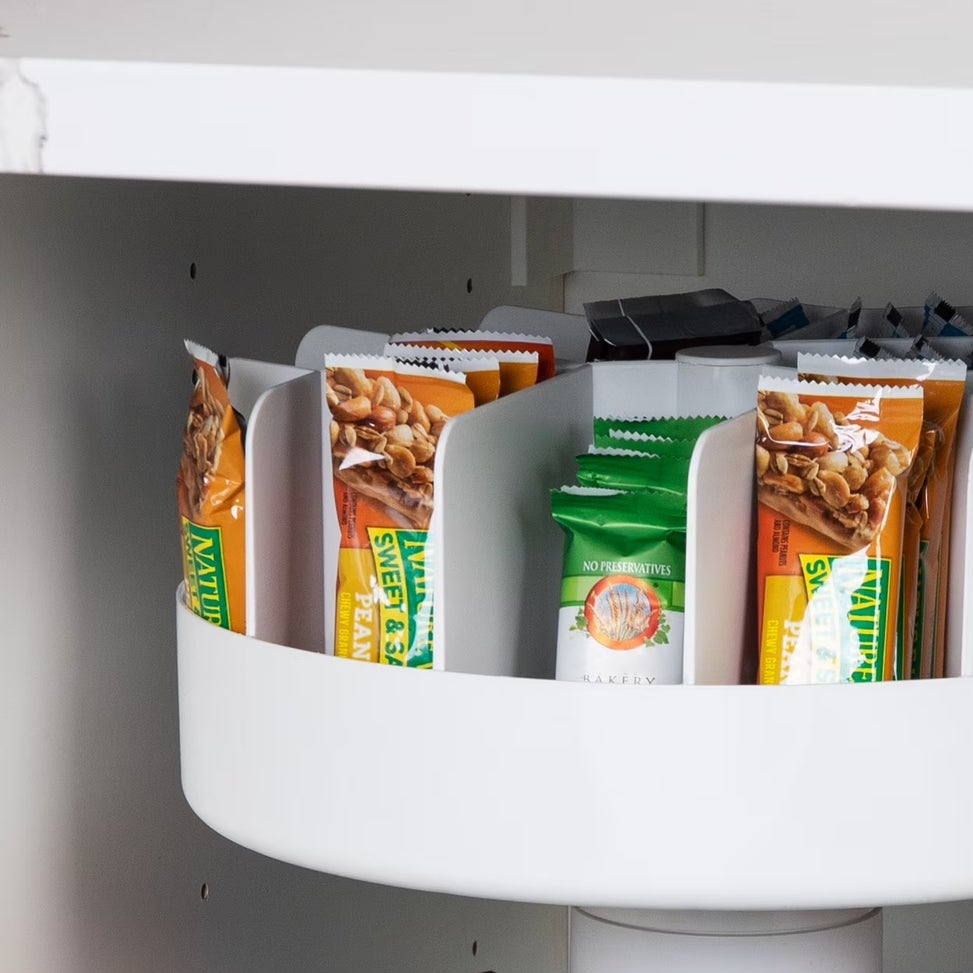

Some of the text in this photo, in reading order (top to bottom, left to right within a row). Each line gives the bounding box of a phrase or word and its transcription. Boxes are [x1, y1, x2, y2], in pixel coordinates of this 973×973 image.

[374, 532, 406, 613] SWEET
[583, 560, 672, 576] NO PRESERVATIVES
